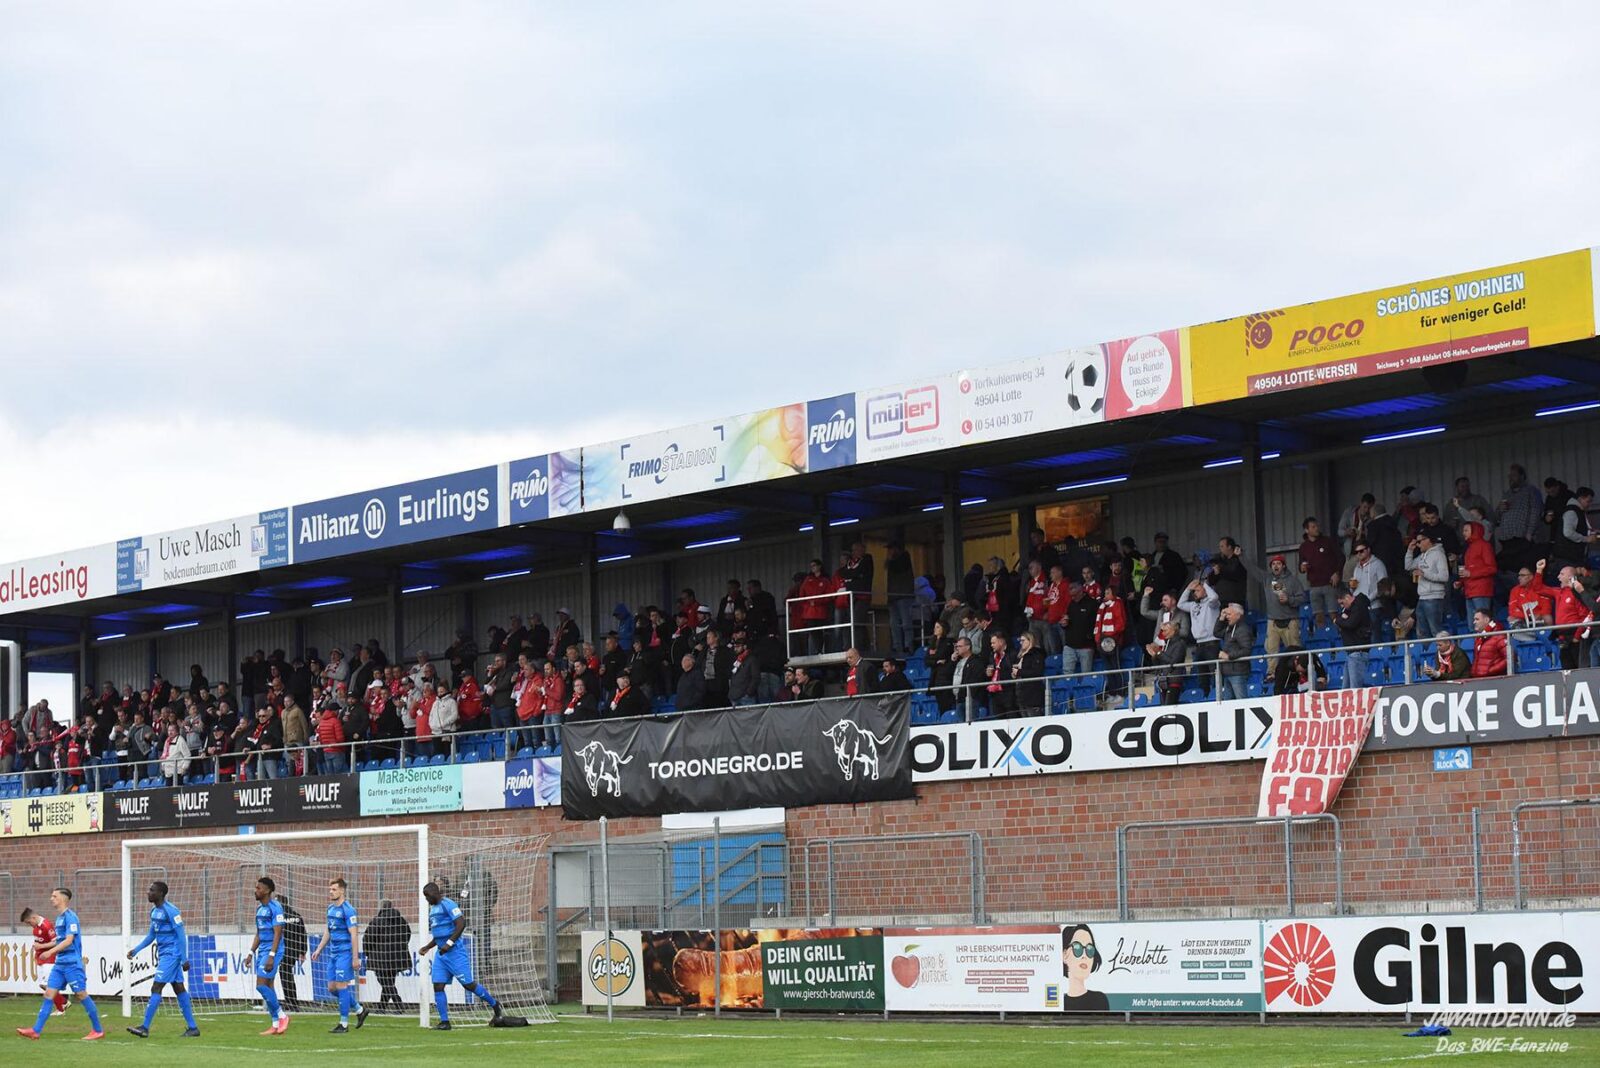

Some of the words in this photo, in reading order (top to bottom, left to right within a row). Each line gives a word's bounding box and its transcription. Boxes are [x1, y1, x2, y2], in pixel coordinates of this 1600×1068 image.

[1376, 286, 1451, 317] SCHÖNES
[1454, 272, 1525, 303] WOHNEN
[1420, 316, 1437, 328] für
[1442, 307, 1489, 322] weniger
[1493, 298, 1526, 314] Geld!
[1289, 319, 1364, 350] POCO
[1127, 352, 1139, 363] Auf
[1035, 366, 1045, 378] 34
[1129, 365, 1142, 375] Das
[1143, 361, 1164, 374] Runde
[1254, 375, 1282, 390] 49504
[1284, 362, 1357, 385] LOTTE-WERSEN
[1133, 377, 1150, 386] muss
[1152, 374, 1162, 383] ins
[974, 392, 999, 407] 49504
[1001, 390, 1022, 402] Lotte
[873, 401, 932, 425] müller
[1012, 412, 1022, 424] 30
[1024, 410, 1034, 422] 77
[808, 417, 855, 446] FRIMO
[510, 475, 548, 501] FRIMO
[299, 511, 359, 544] Allianz
[399, 488, 489, 527] Eurlings
[159, 536, 191, 561] Uwe
[195, 523, 241, 555] Masch
[163, 558, 237, 581] bodenundraum.com
[0, 560, 87, 603] al-Leasing
[1373, 689, 1499, 738] TOCKE
[1513, 681, 1600, 728] GLA
[910, 724, 1073, 773] OLIXO
[648, 751, 803, 779] TORONEGRO.DE
[1272, 747, 1352, 775] ASOZIA
[1454, 749, 1469, 769] Q
[304, 783, 341, 803] WULFF
[367, 788, 391, 797] Garten-
[391, 787, 404, 796] und
[404, 784, 453, 795] Friedhofspflege
[506, 775, 533, 791] FRIMO
[119, 796, 150, 815] WULFF
[177, 791, 210, 811] WULFF
[238, 787, 273, 807] WULFF
[1267, 776, 1345, 816] FA
[46, 813, 74, 826] HEESCH
[955, 945, 968, 953] IHR
[969, 944, 1045, 953] LEBENSMITTELPUNKT
[1213, 948, 1218, 956] &
[1220, 939, 1252, 947] VERWEILEN
[767, 946, 800, 964] DEIN
[803, 944, 845, 962] GRILL
[956, 955, 976, 963] LOTTE
[1009, 954, 1050, 963] MARKTTAG
[1353, 923, 1584, 1005] Gilne
[100, 956, 123, 984] Bitt
[592, 954, 632, 980] Girsch
[767, 968, 802, 985] WILL
[804, 961, 875, 985] QUALITÄT
[783, 988, 875, 1001] www.giersch-bratwurst.de
[1132, 998, 1147, 1006] Mehr
[1147, 998, 1162, 1008] Infos
[1181, 998, 1244, 1007] www.cord-kutsche.de
